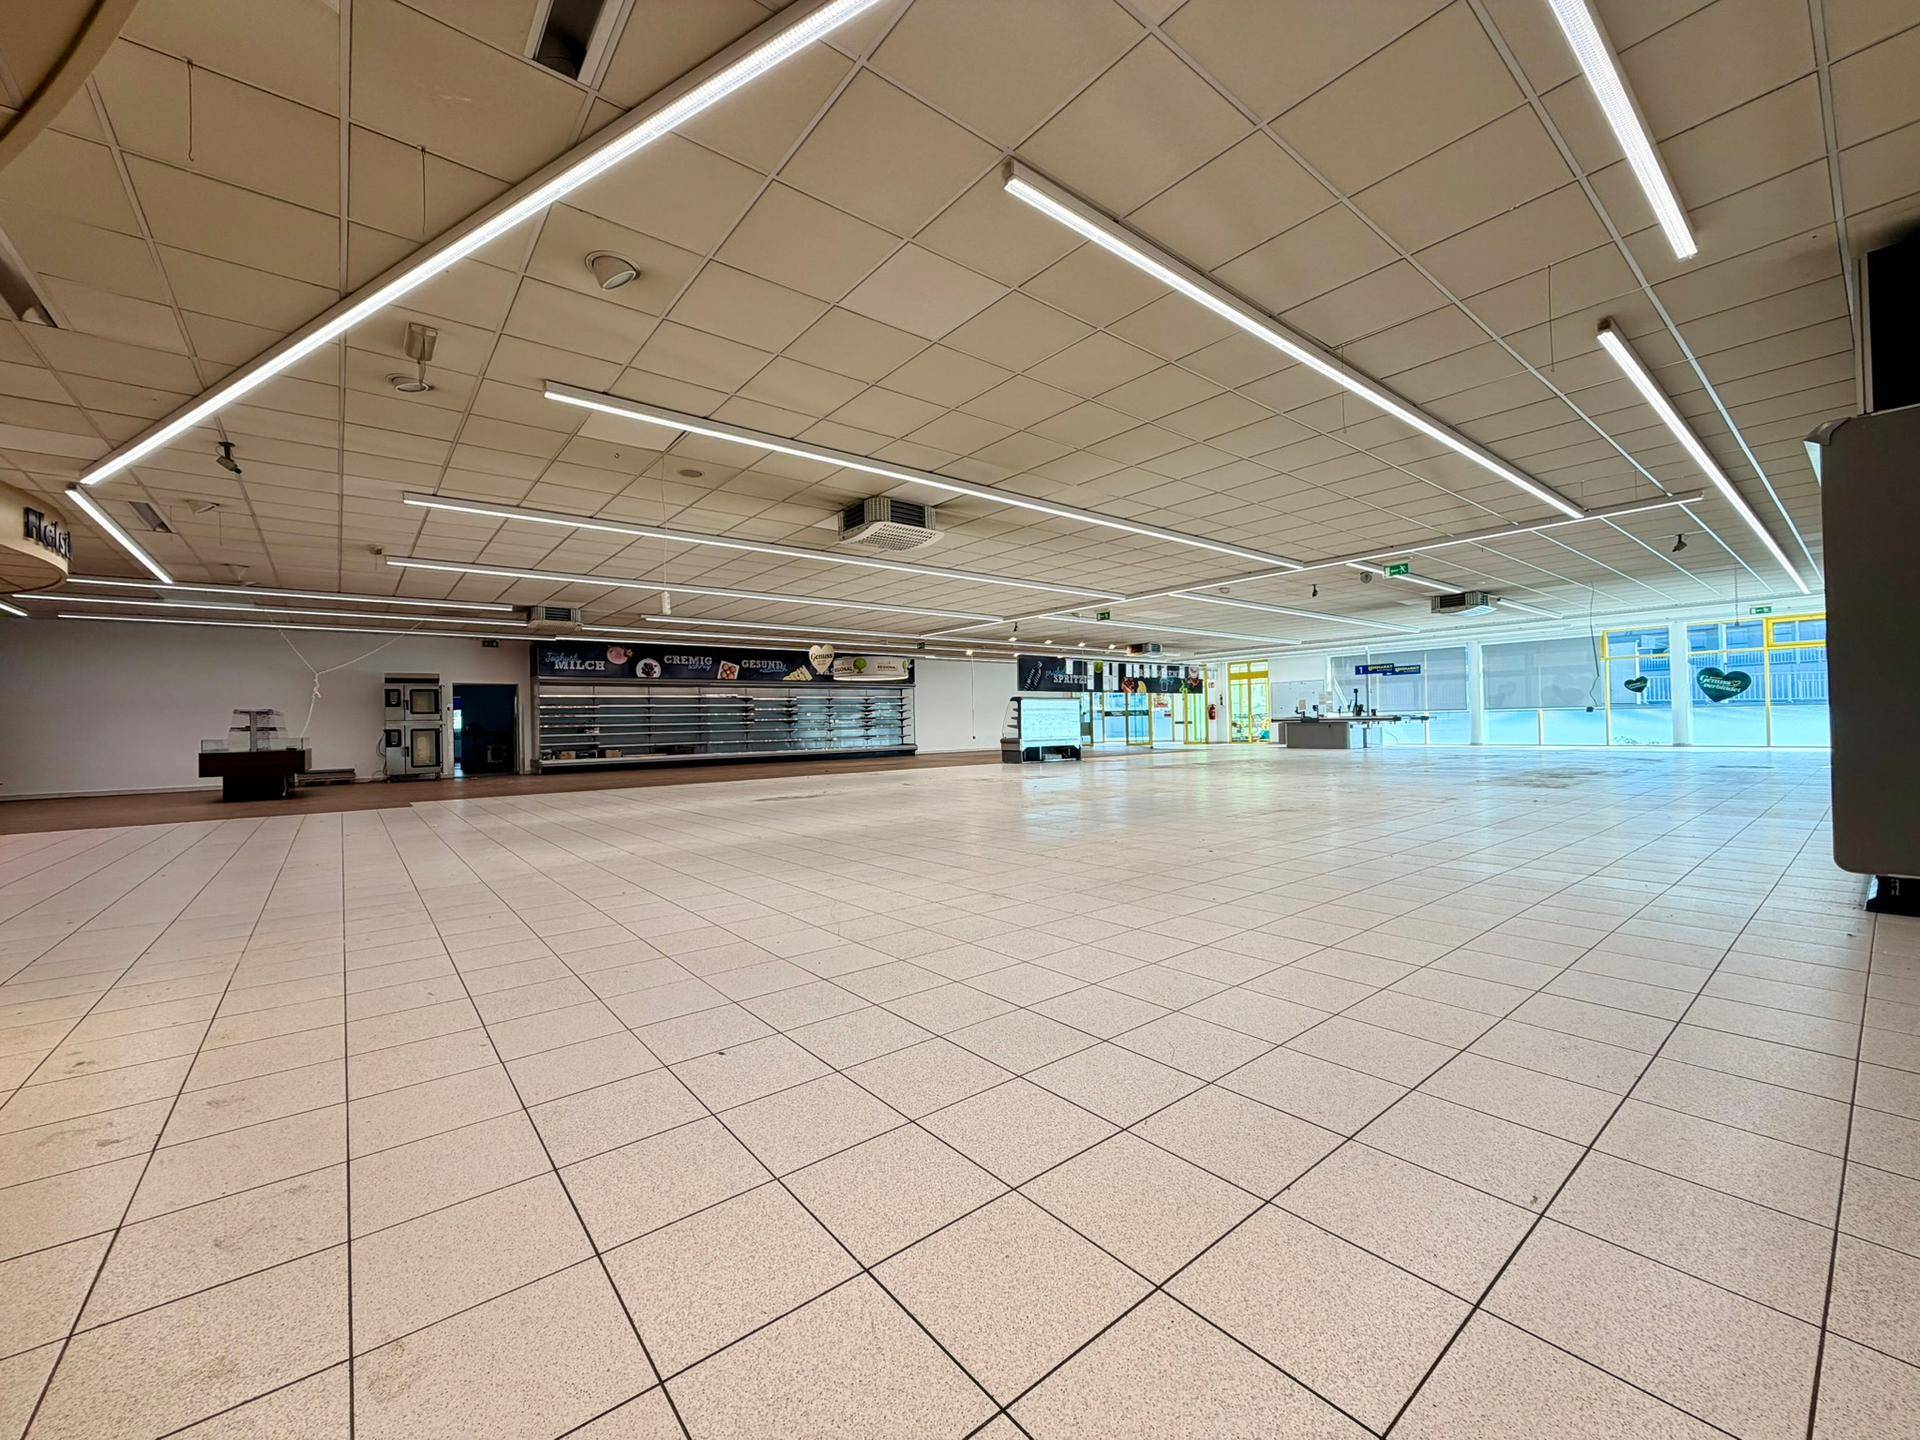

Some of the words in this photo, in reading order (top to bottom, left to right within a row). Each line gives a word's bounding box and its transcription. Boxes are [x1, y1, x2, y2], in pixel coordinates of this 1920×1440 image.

[554, 660, 606, 671] MILCH
[664, 655, 713, 666] CREMIG
[741, 660, 783, 670] GESUND
[1053, 674, 1088, 685] SPRITZI
